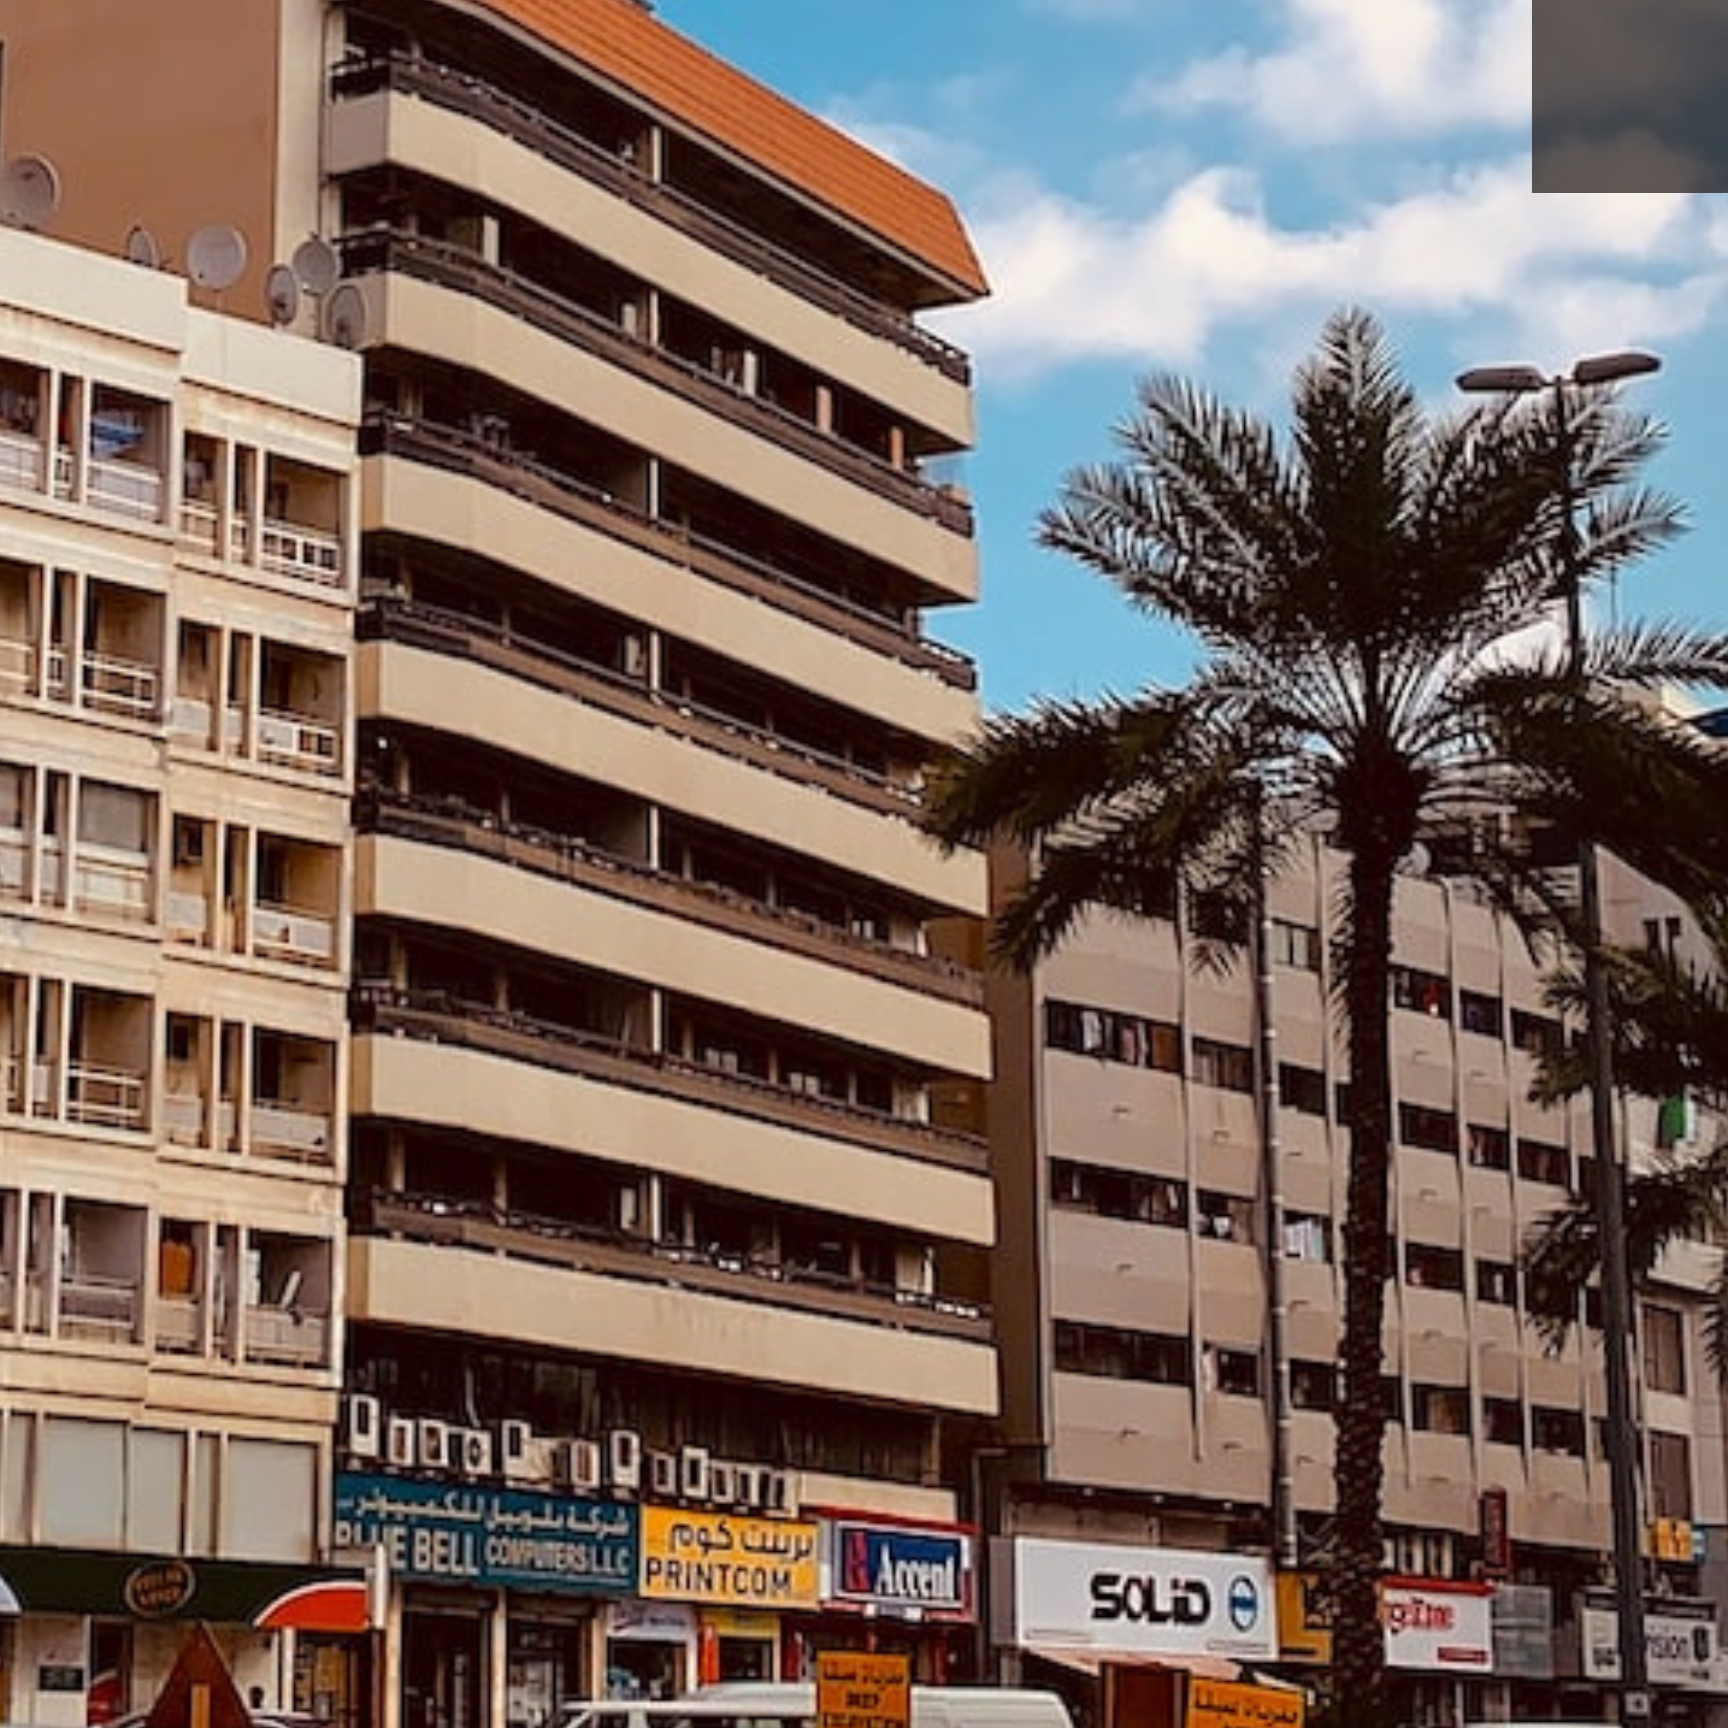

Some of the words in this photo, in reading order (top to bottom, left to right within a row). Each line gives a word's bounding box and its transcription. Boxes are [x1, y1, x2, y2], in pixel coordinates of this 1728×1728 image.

[335, 1521, 408, 1569] BLUE
[413, 1527, 481, 1575] BELL
[484, 1537, 586, 1572] COMPUTERS
[875, 1541, 956, 1601] Accent
[646, 1556, 791, 1597] PRINTCOM
